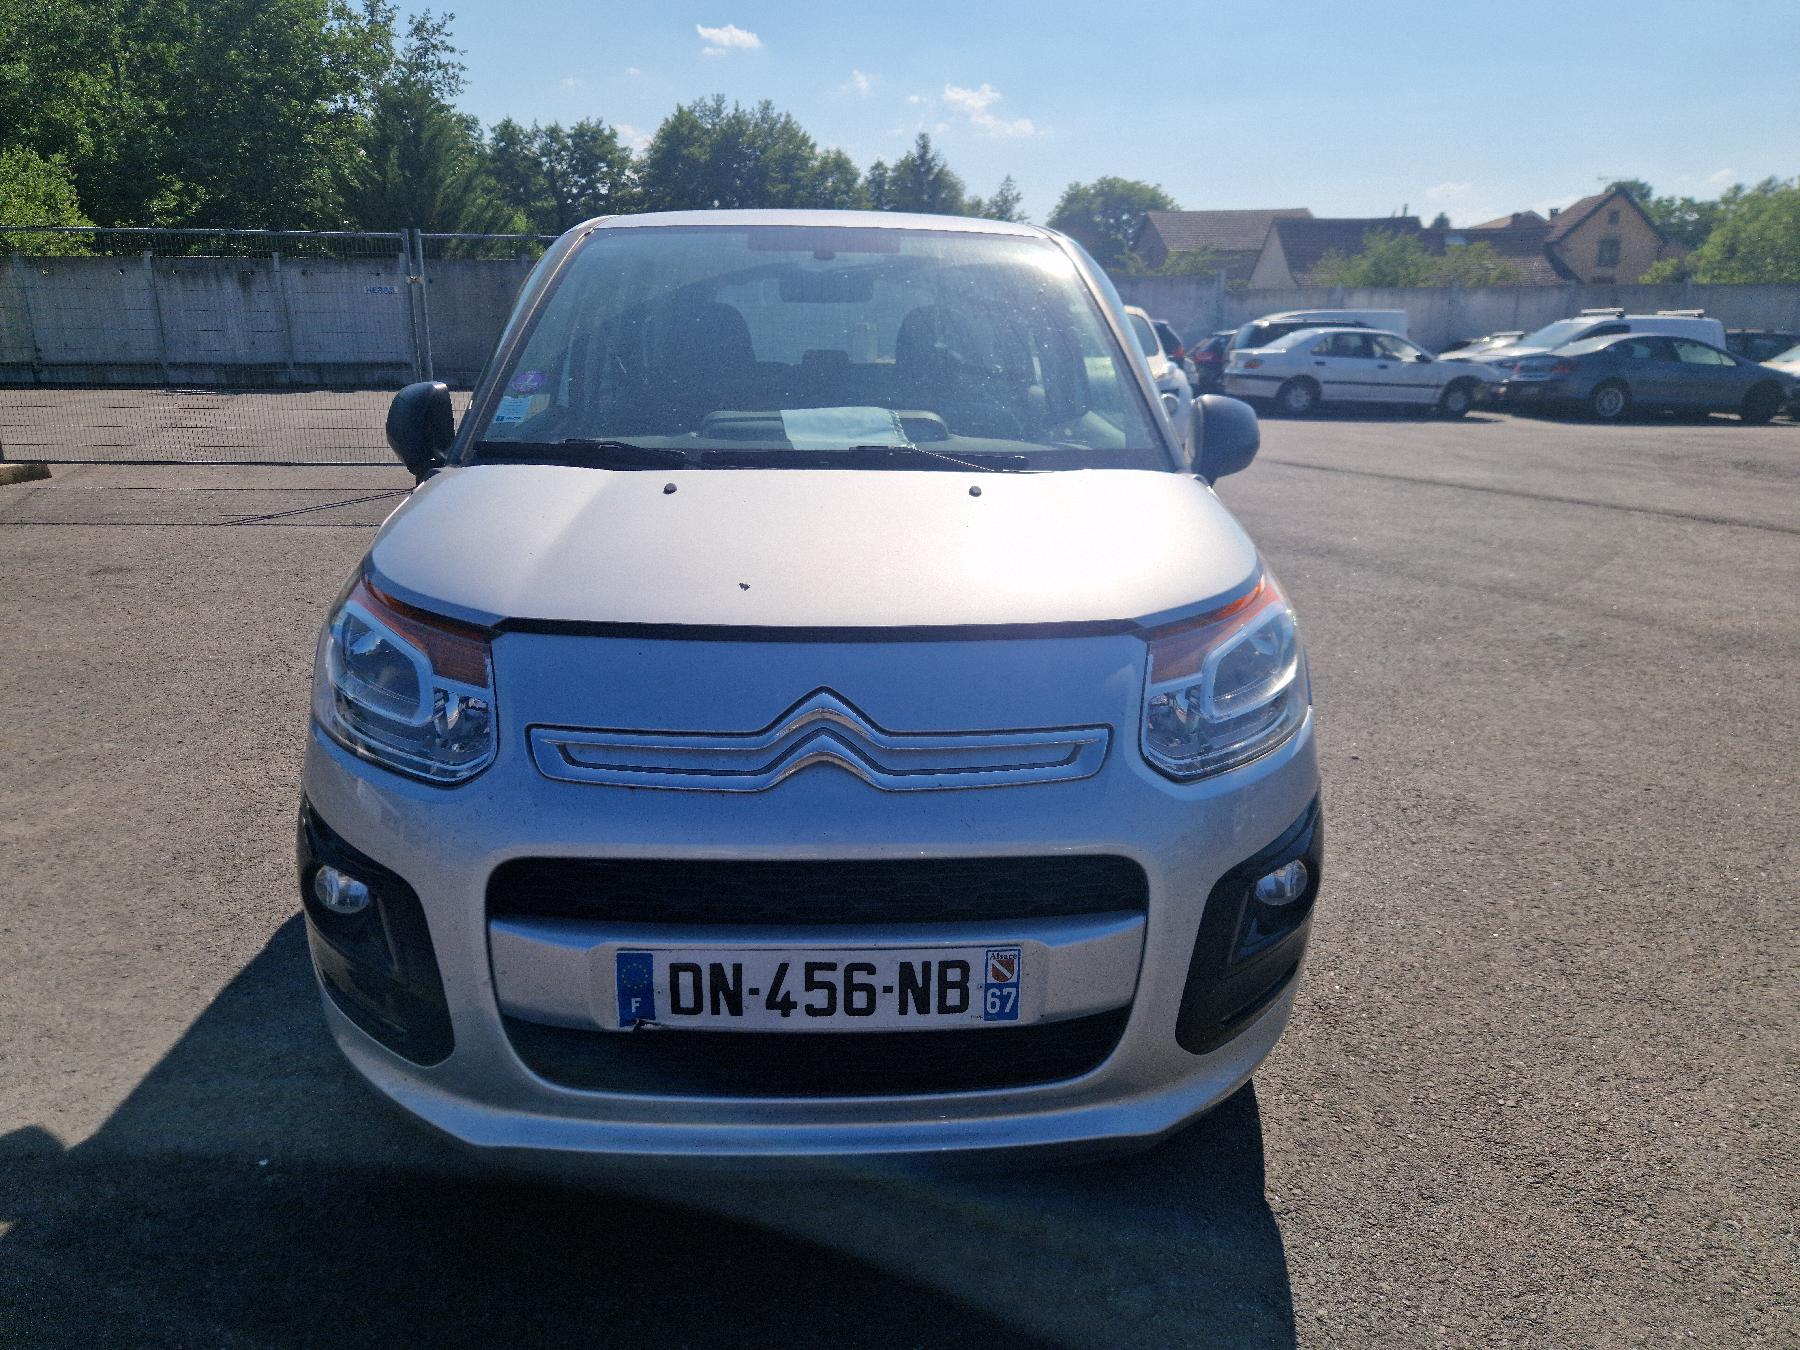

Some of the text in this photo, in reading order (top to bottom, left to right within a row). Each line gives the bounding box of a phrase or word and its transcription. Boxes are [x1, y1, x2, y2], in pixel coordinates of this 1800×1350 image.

[990, 952, 1018, 960] Alsace
[669, 960, 971, 1018] DN-456-NB
[631, 997, 642, 1013] F
[986, 987, 1017, 1014] 67
